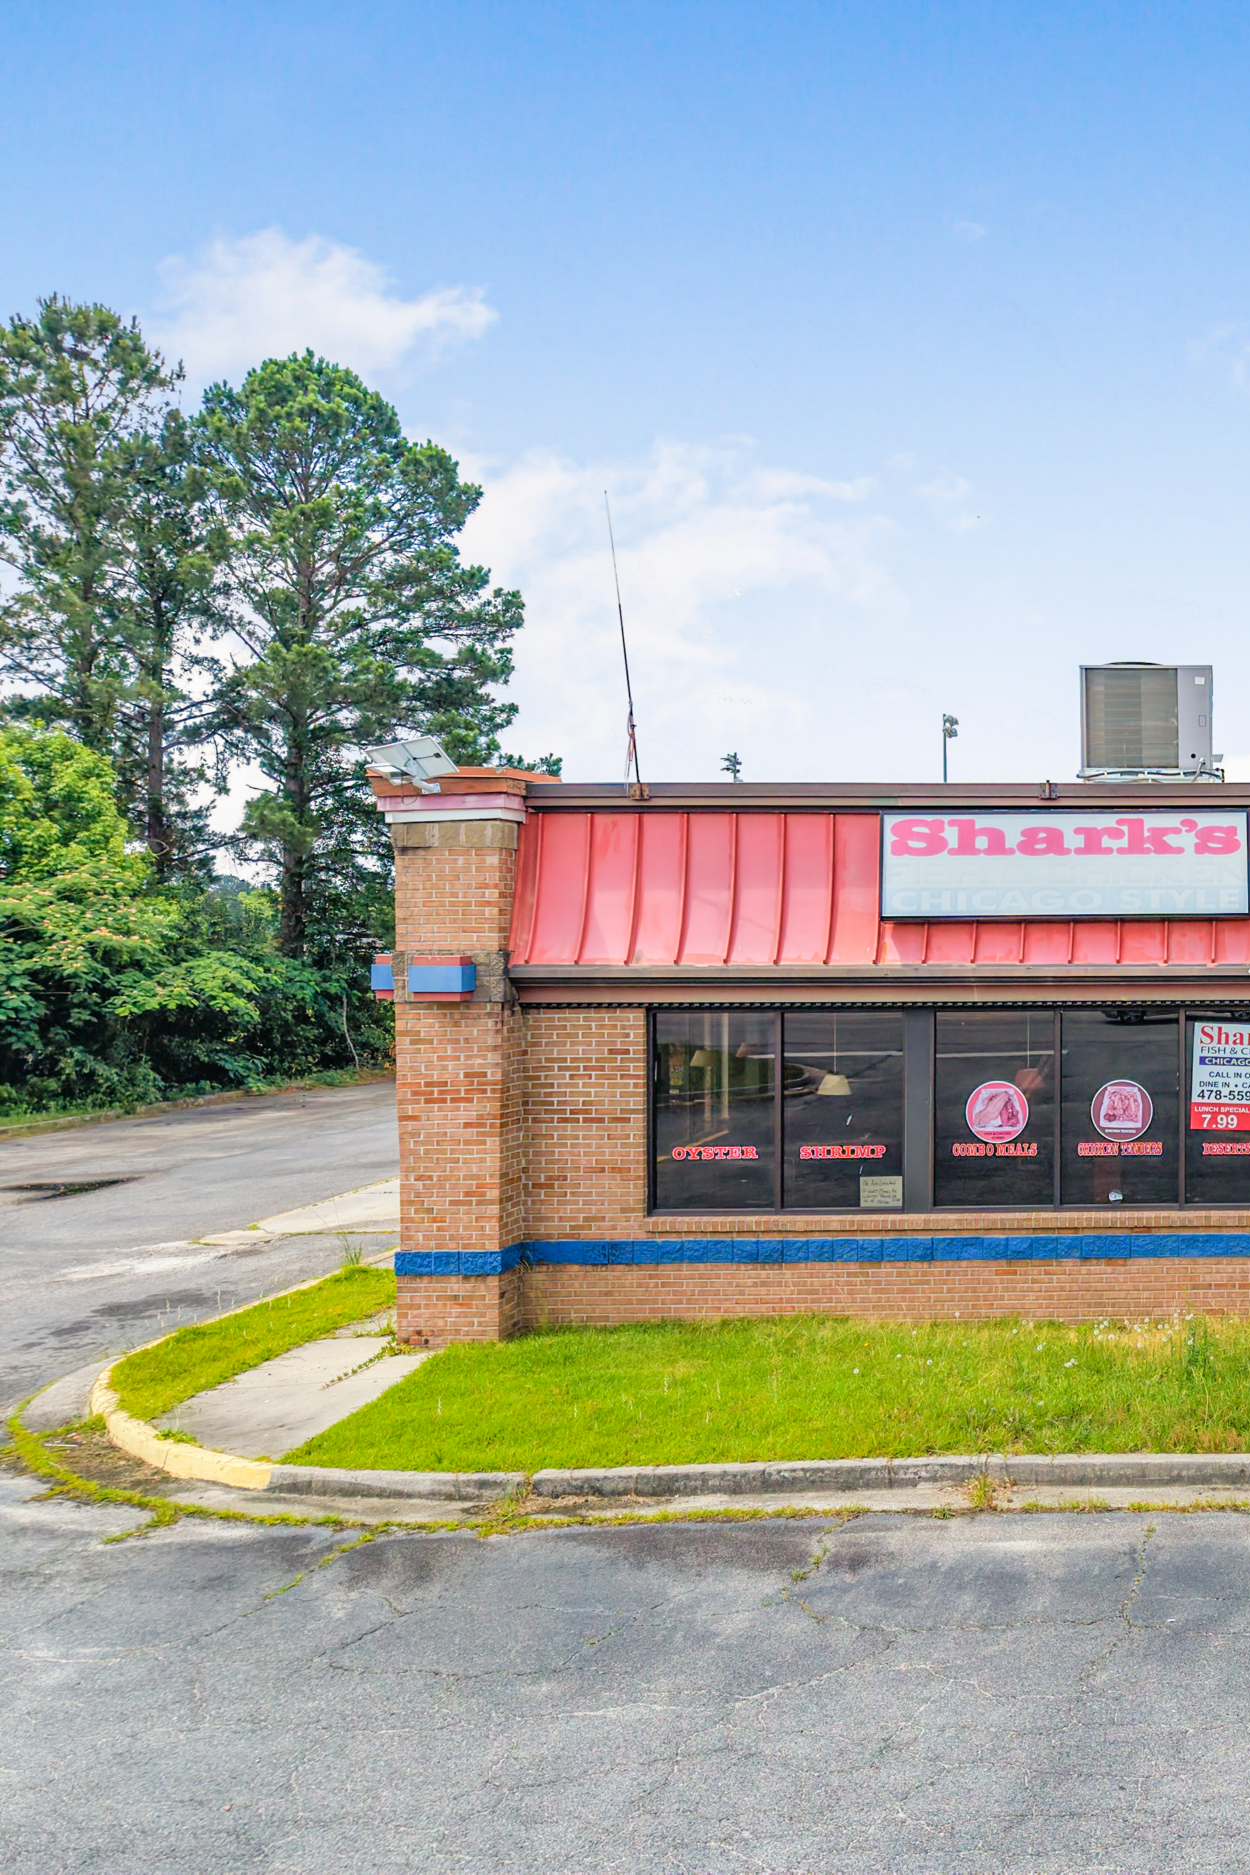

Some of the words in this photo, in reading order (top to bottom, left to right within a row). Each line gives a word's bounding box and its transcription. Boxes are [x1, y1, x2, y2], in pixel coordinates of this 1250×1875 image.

[890, 818, 1242, 857] Shark's
[891, 889, 1103, 911] CHICAGO
[1119, 888, 1240, 910] STYLE
[1200, 1046, 1226, 1055] FISH
[1229, 1047, 1238, 1055] &
[1208, 1071, 1231, 1079] CALL
[1220, 1106, 1250, 1114] SPECIAL
[1201, 1114, 1238, 1129] 7.99
[671, 1146, 759, 1160] OYSTER
[800, 1145, 886, 1159] SHRIMP
[952, 1143, 994, 1156] COMBO
[995, 1143, 1038, 1156] MEALS
[1078, 1142, 1119, 1156] CHICKEN
[1120, 1141, 1162, 1156] TENDERS
